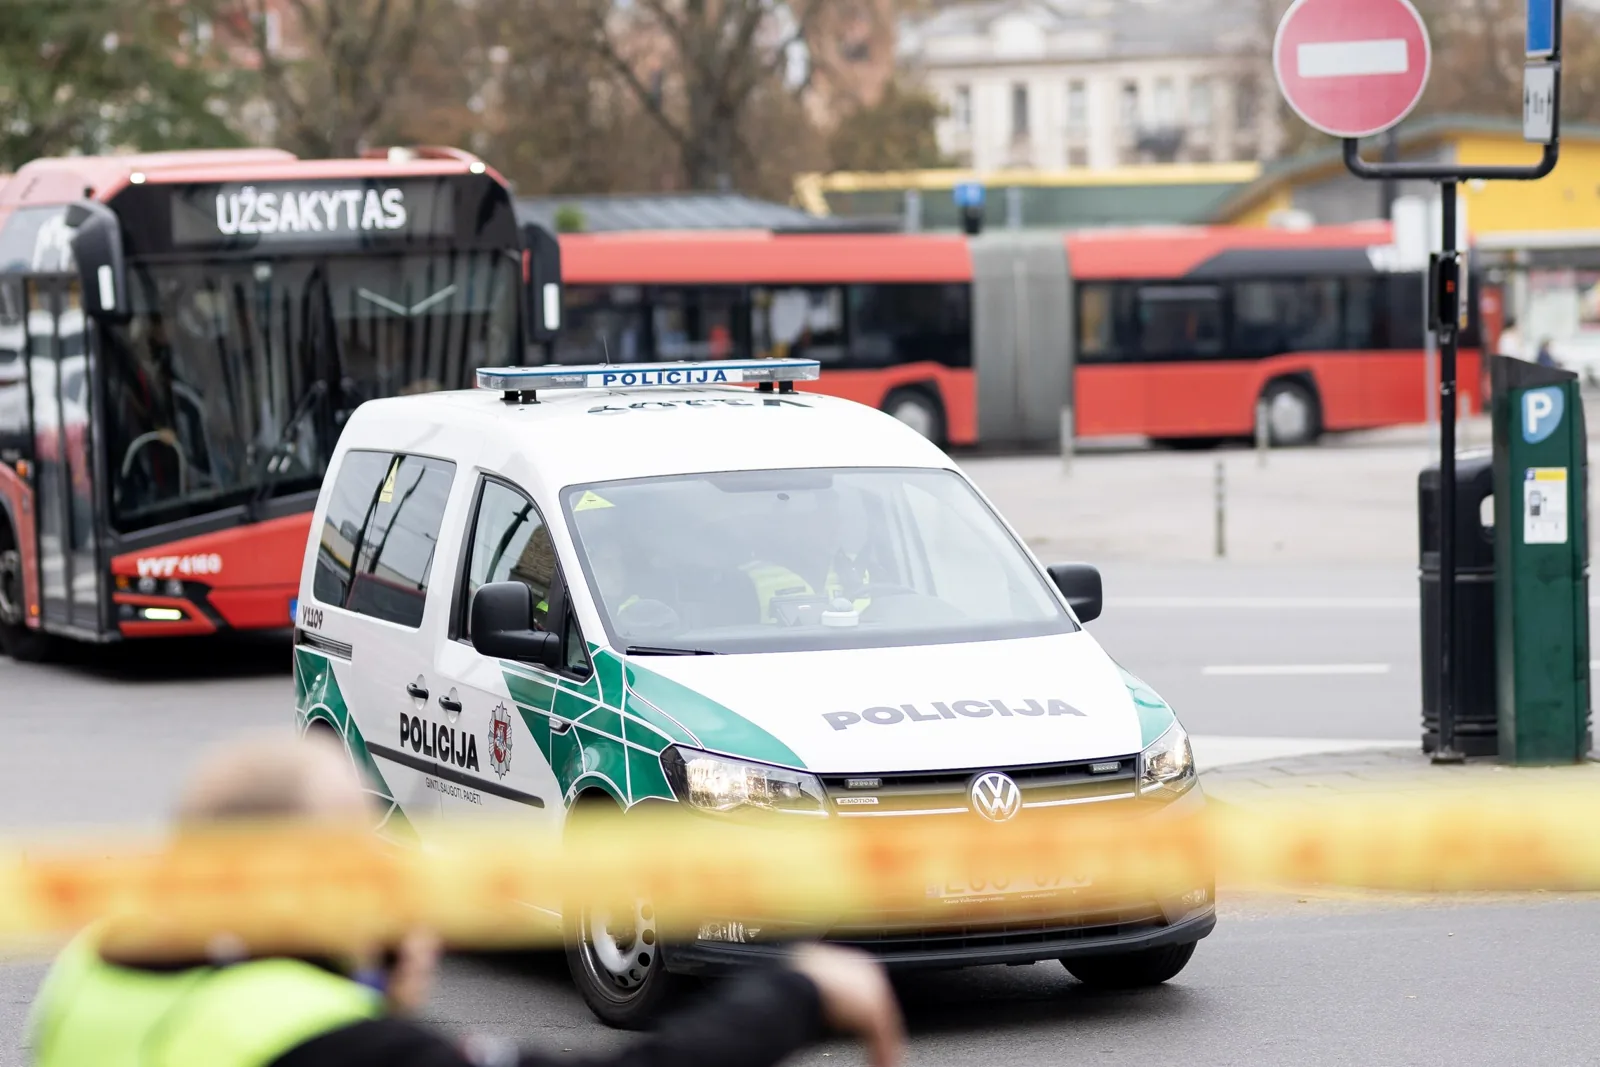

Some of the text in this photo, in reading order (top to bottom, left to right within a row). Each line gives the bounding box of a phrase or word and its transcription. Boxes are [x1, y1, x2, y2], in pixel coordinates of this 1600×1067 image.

[216, 185, 406, 235] UŽSAKYTAS
[603, 369, 728, 386] POLICIJA
[1526, 392, 1553, 434] P
[302, 604, 324, 630] V1109
[821, 699, 1089, 731] POLICIJA
[400, 711, 480, 773] POLICIJA
